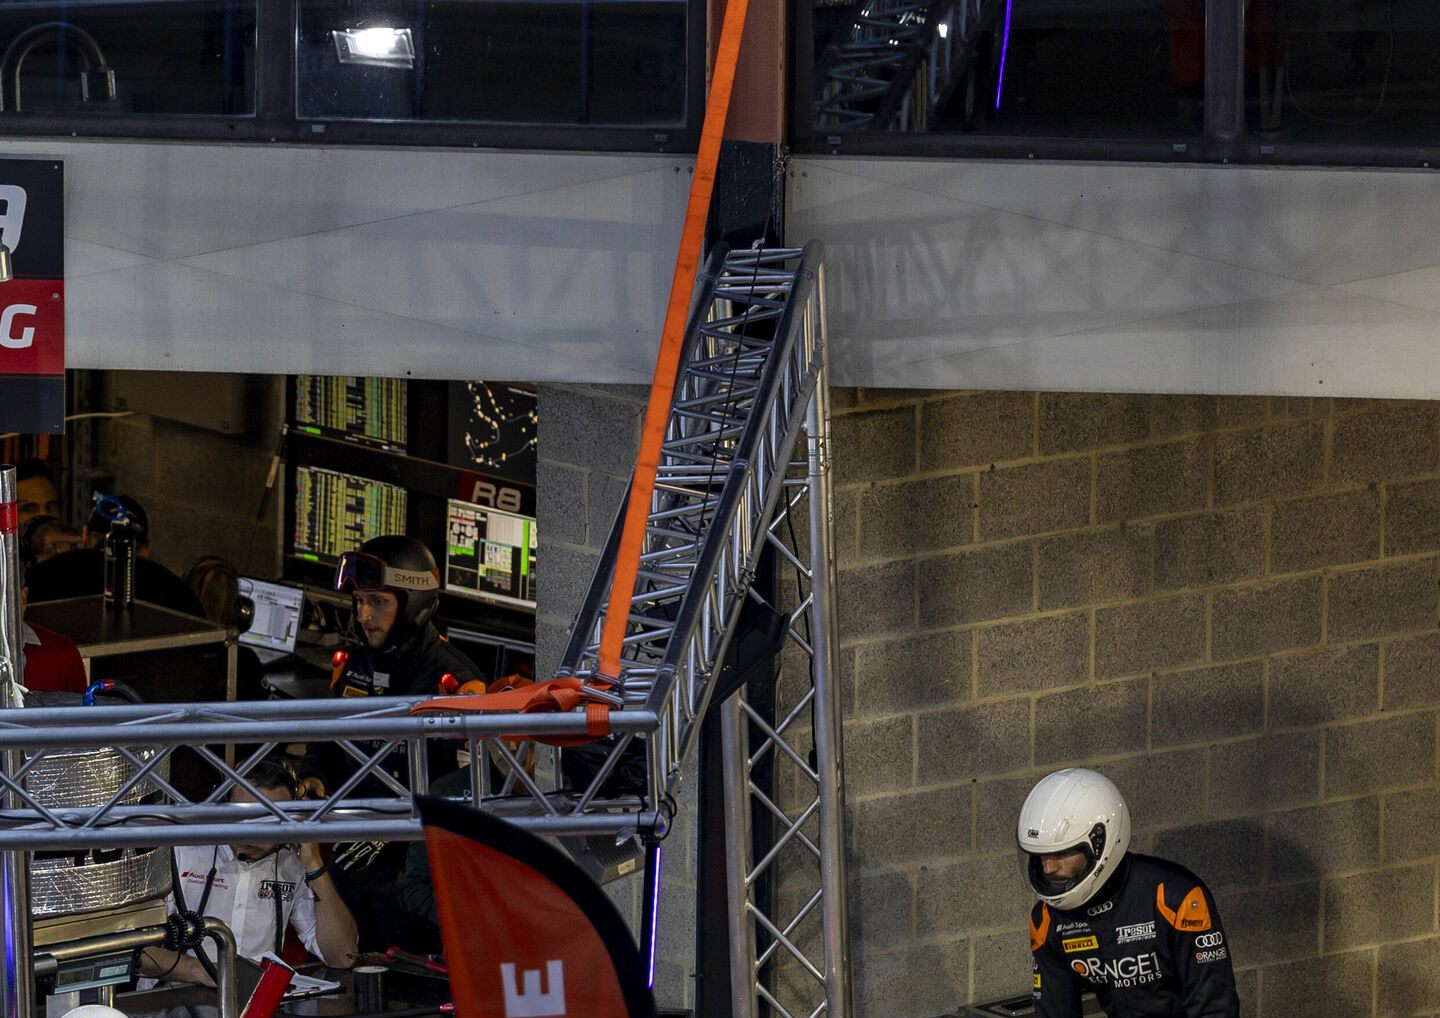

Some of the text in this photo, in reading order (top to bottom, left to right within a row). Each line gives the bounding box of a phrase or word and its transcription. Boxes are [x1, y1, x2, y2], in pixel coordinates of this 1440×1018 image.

[471, 480, 522, 513] R8
[394, 573, 430, 586] SMITH
[1116, 921, 1156, 939] Tresor
[1064, 938, 1094, 951] PIRELLI
[1114, 971, 1163, 988] MOTORS
